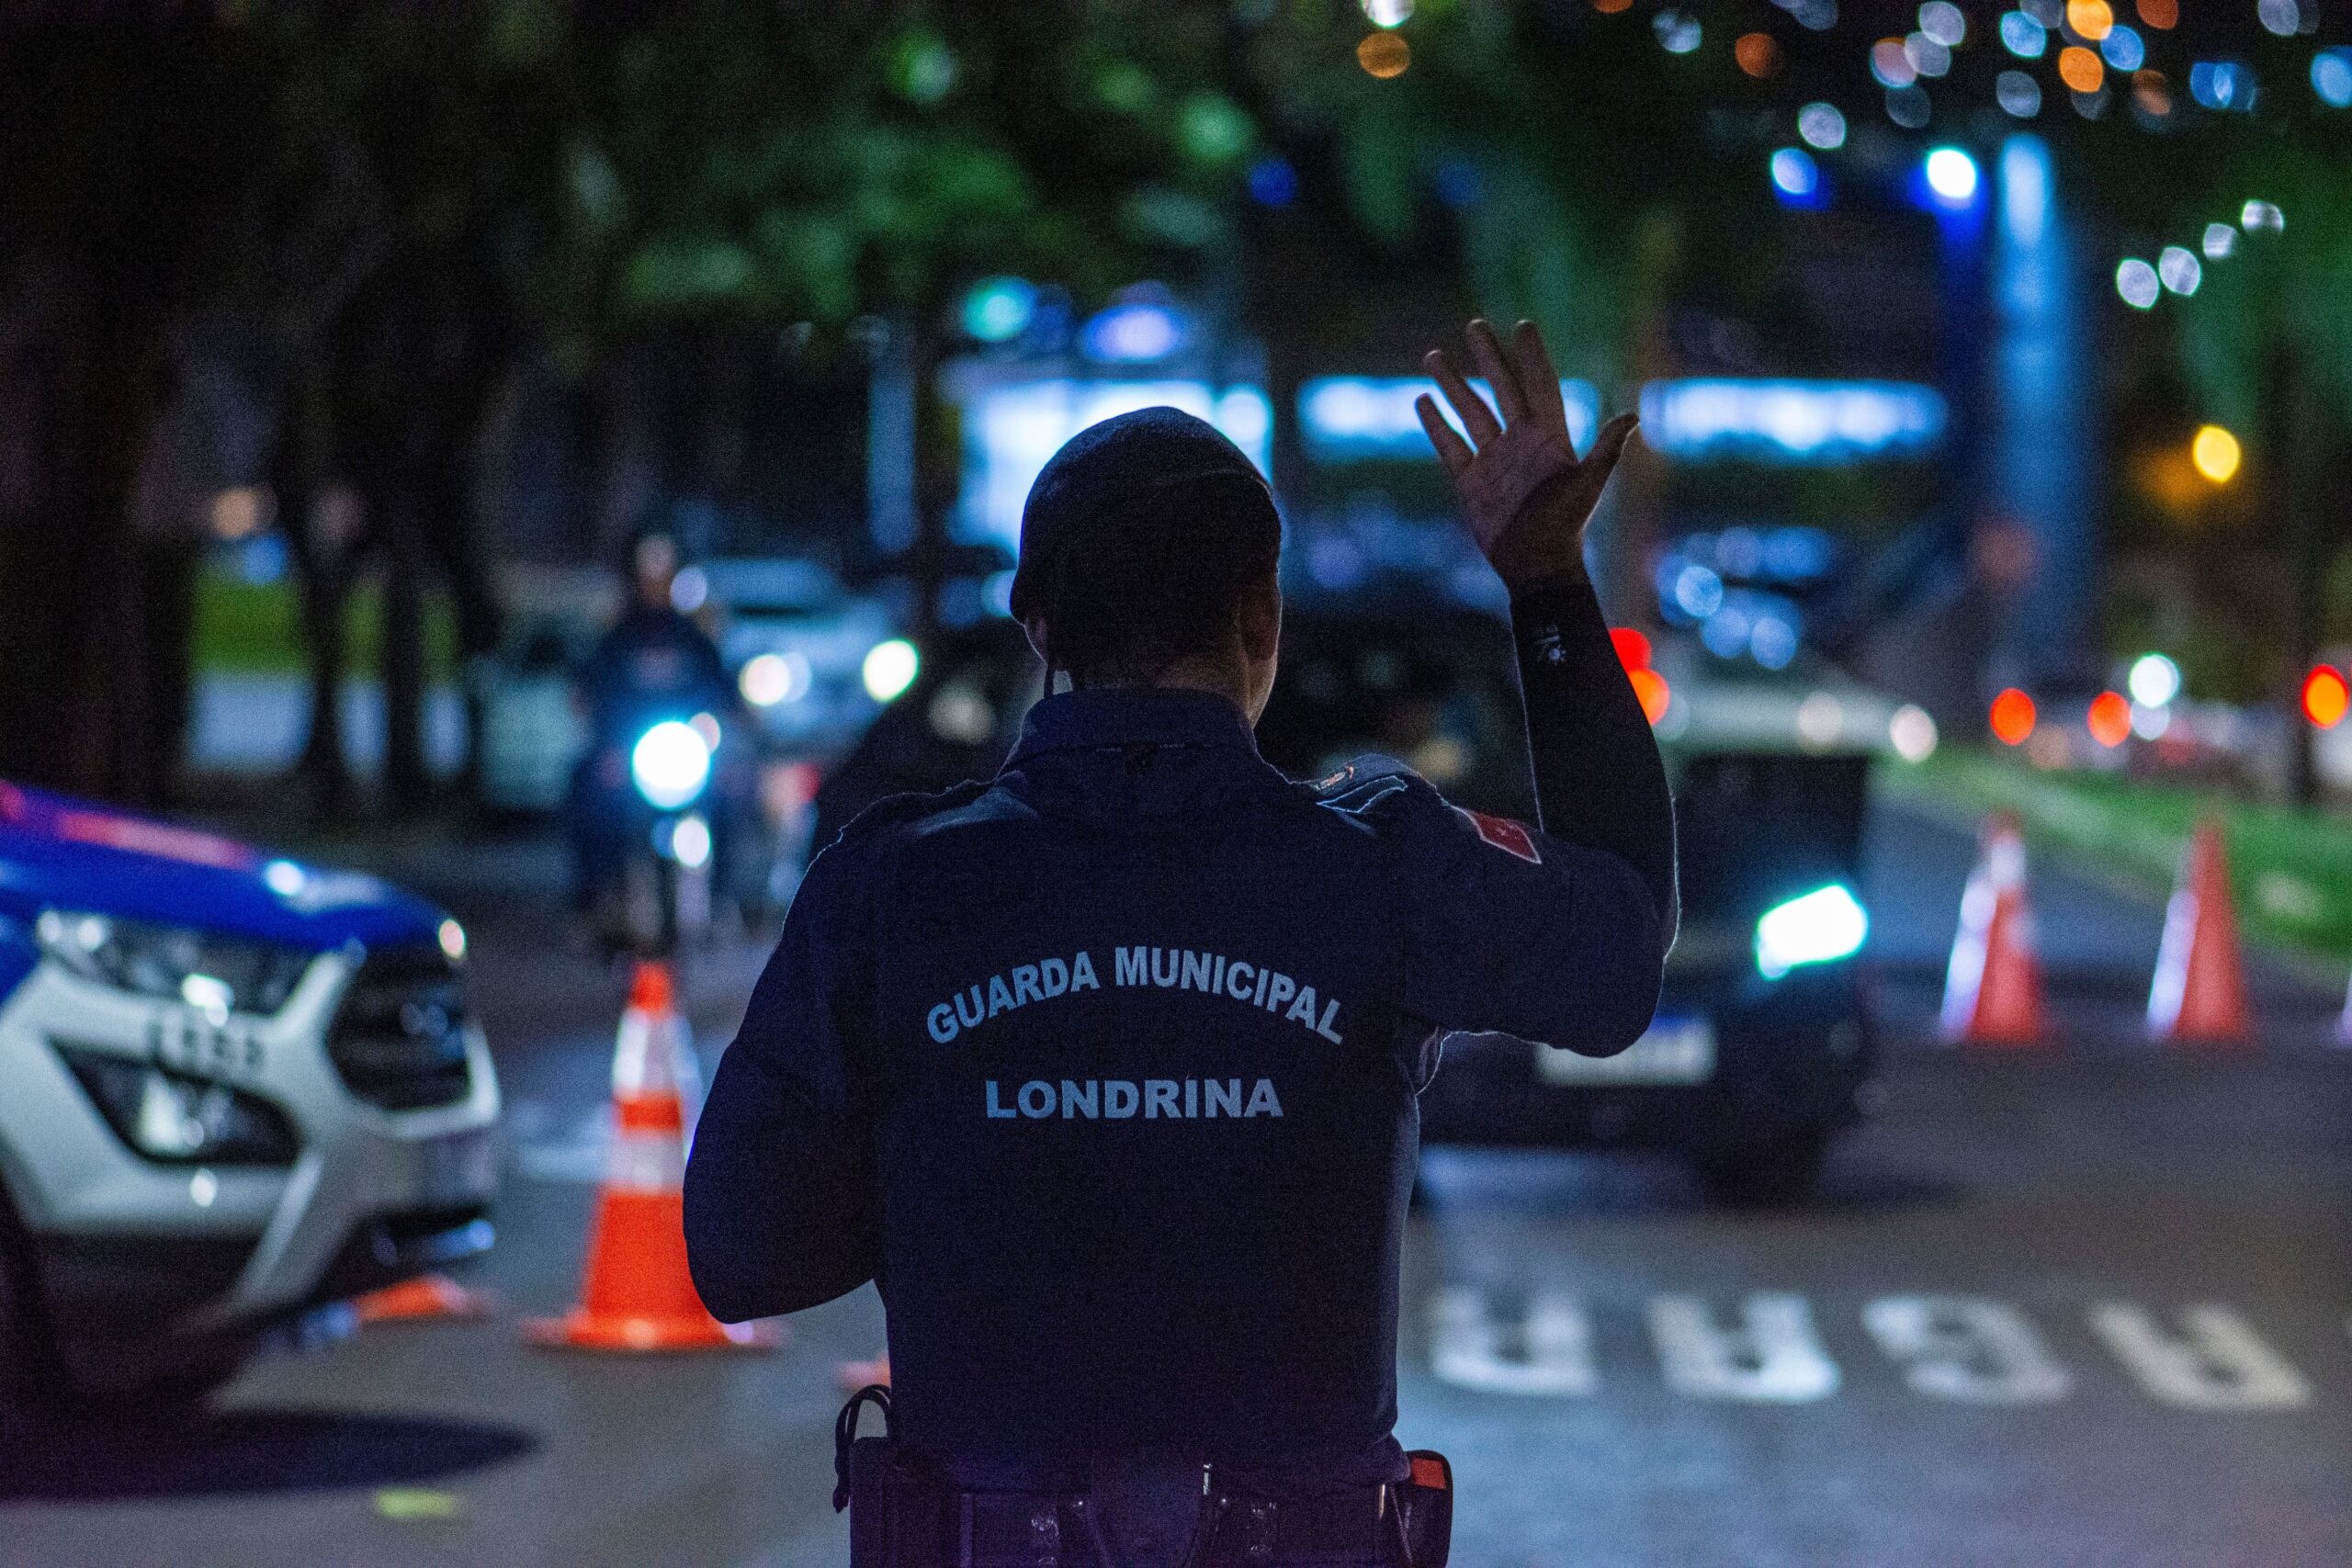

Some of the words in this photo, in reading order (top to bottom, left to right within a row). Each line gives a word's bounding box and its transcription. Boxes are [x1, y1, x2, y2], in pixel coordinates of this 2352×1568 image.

[927, 951, 1100, 1043] GUARDA
[1114, 946, 1343, 1045] MUNICIPAL
[986, 1078, 1283, 1119] LONDRINA
